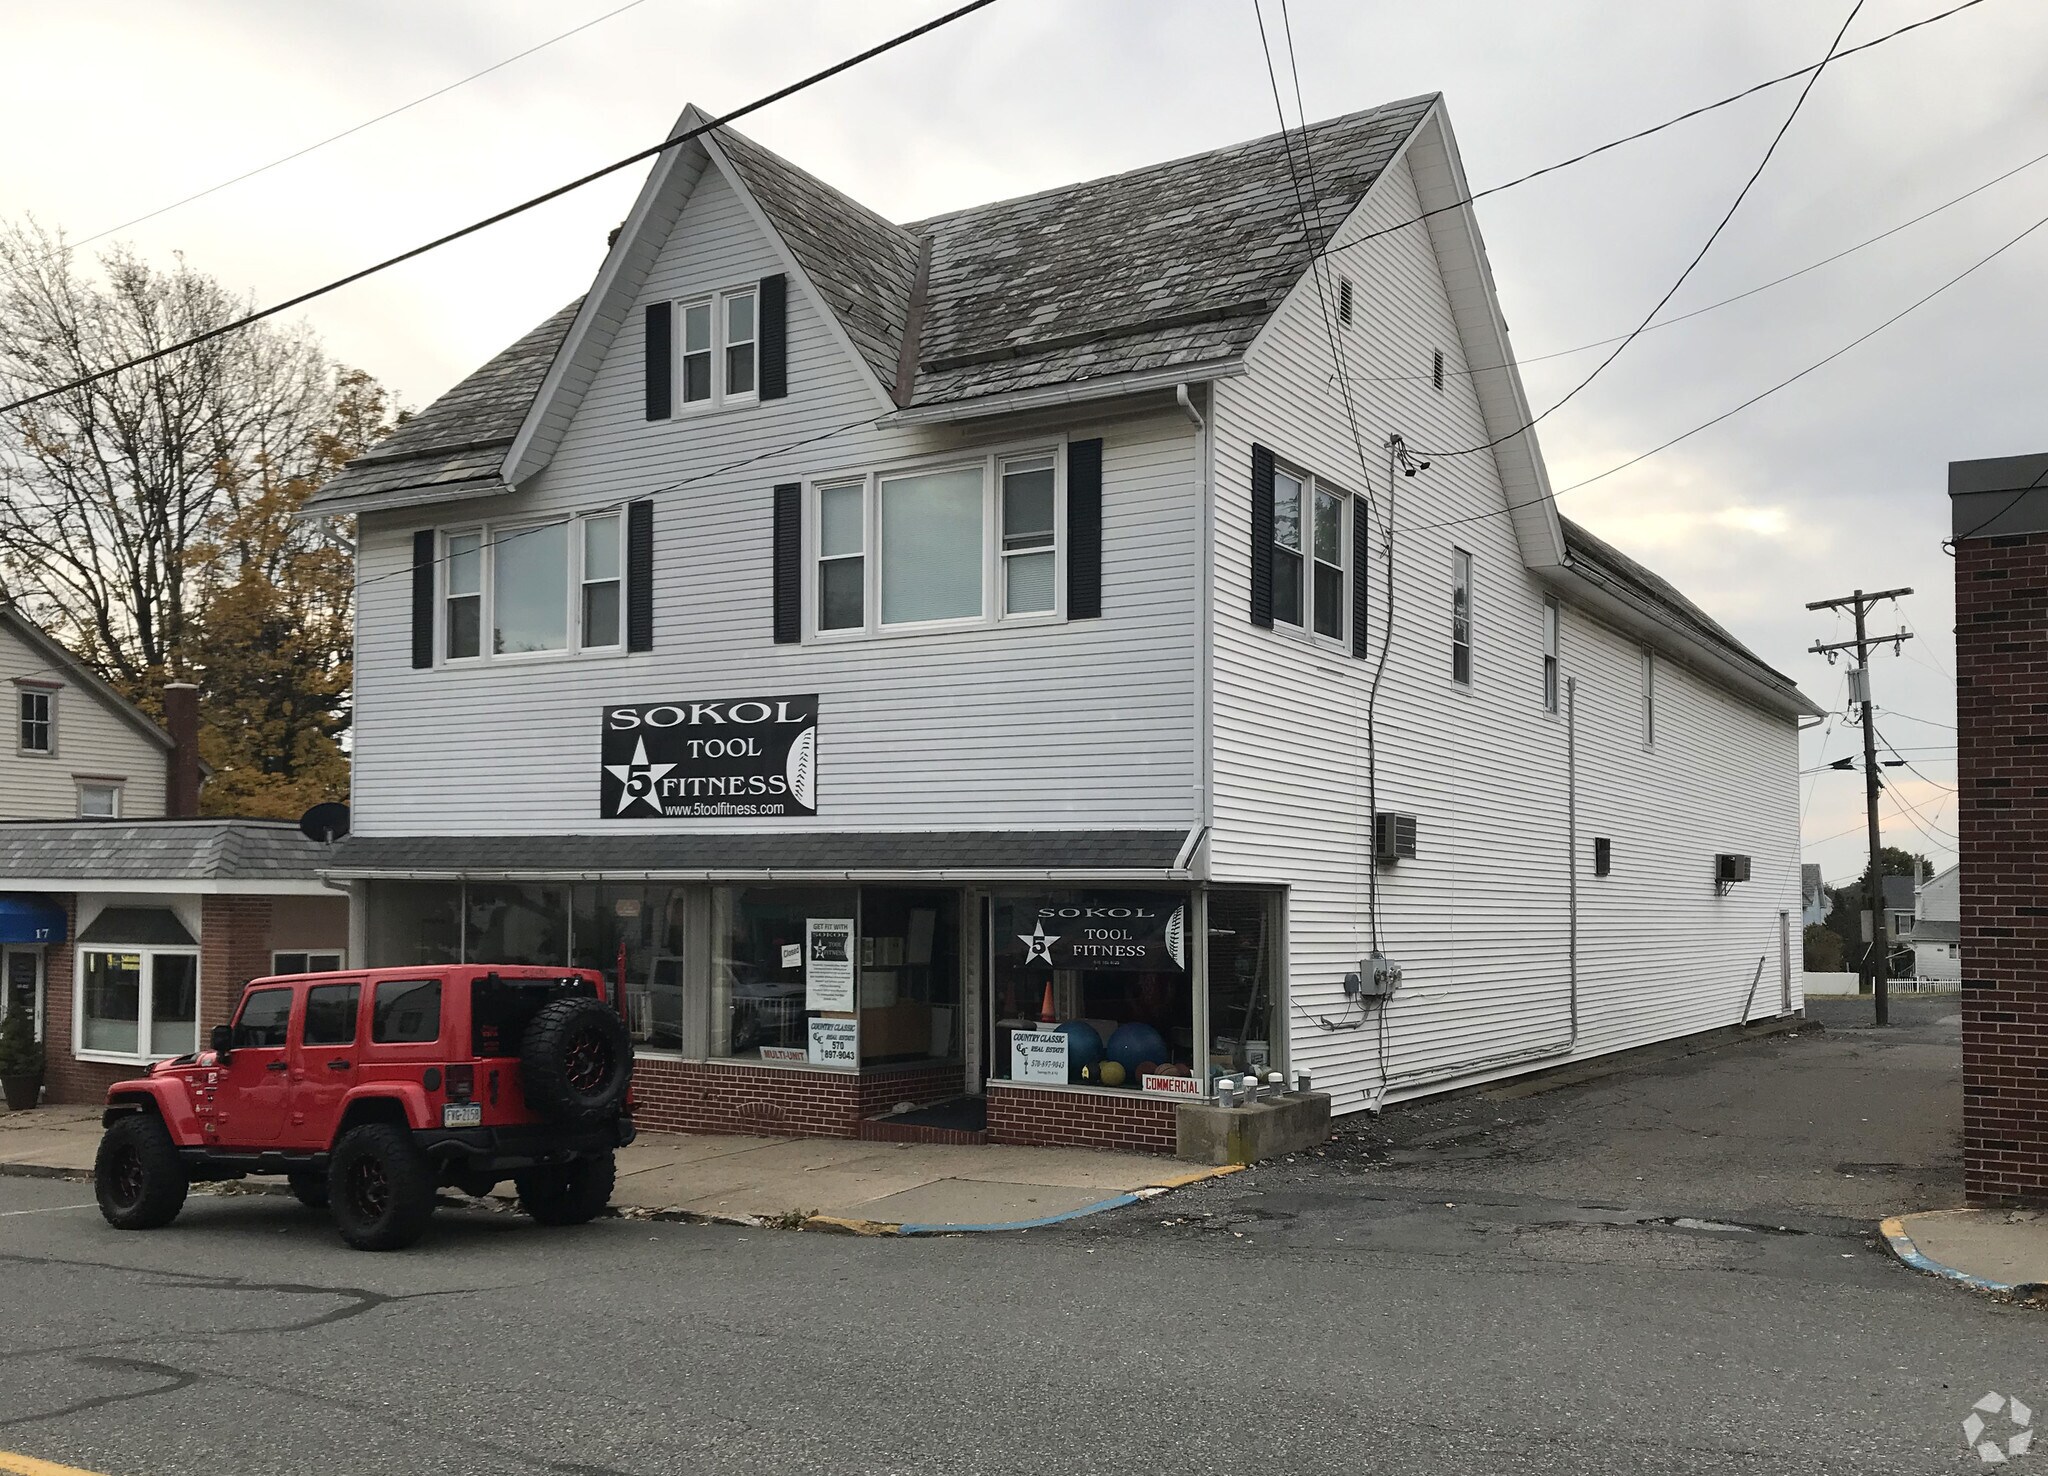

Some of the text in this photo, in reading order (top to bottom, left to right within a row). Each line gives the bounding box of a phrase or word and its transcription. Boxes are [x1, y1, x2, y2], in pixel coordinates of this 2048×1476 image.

[610, 702, 808, 730] SOKOL
[687, 737, 763, 759] TOOL
[626, 764, 653, 798] 5
[662, 774, 788, 797] FITNESS
[665, 802, 785, 816] www.5toolfitness.com
[1038, 908, 1156, 918] SOKOL
[35, 928, 50, 939] 17
[1084, 928, 1133, 941] TOOL
[1031, 936, 1047, 954] 5
[1073, 945, 1147, 957] FITNESS
[811, 1022, 856, 1032] COUNTRY CLASSIC
[1013, 1033, 1066, 1044] COUNTRY CLASSIC
[832, 1041, 845, 1050] 570
[1030, 1045, 1065, 1054] REAL ESTATE
[763, 1049, 805, 1061] MULTI-UNIT
[824, 1050, 855, 1060] 897-9043
[1145, 1076, 1200, 1095] COMMERCIAL
